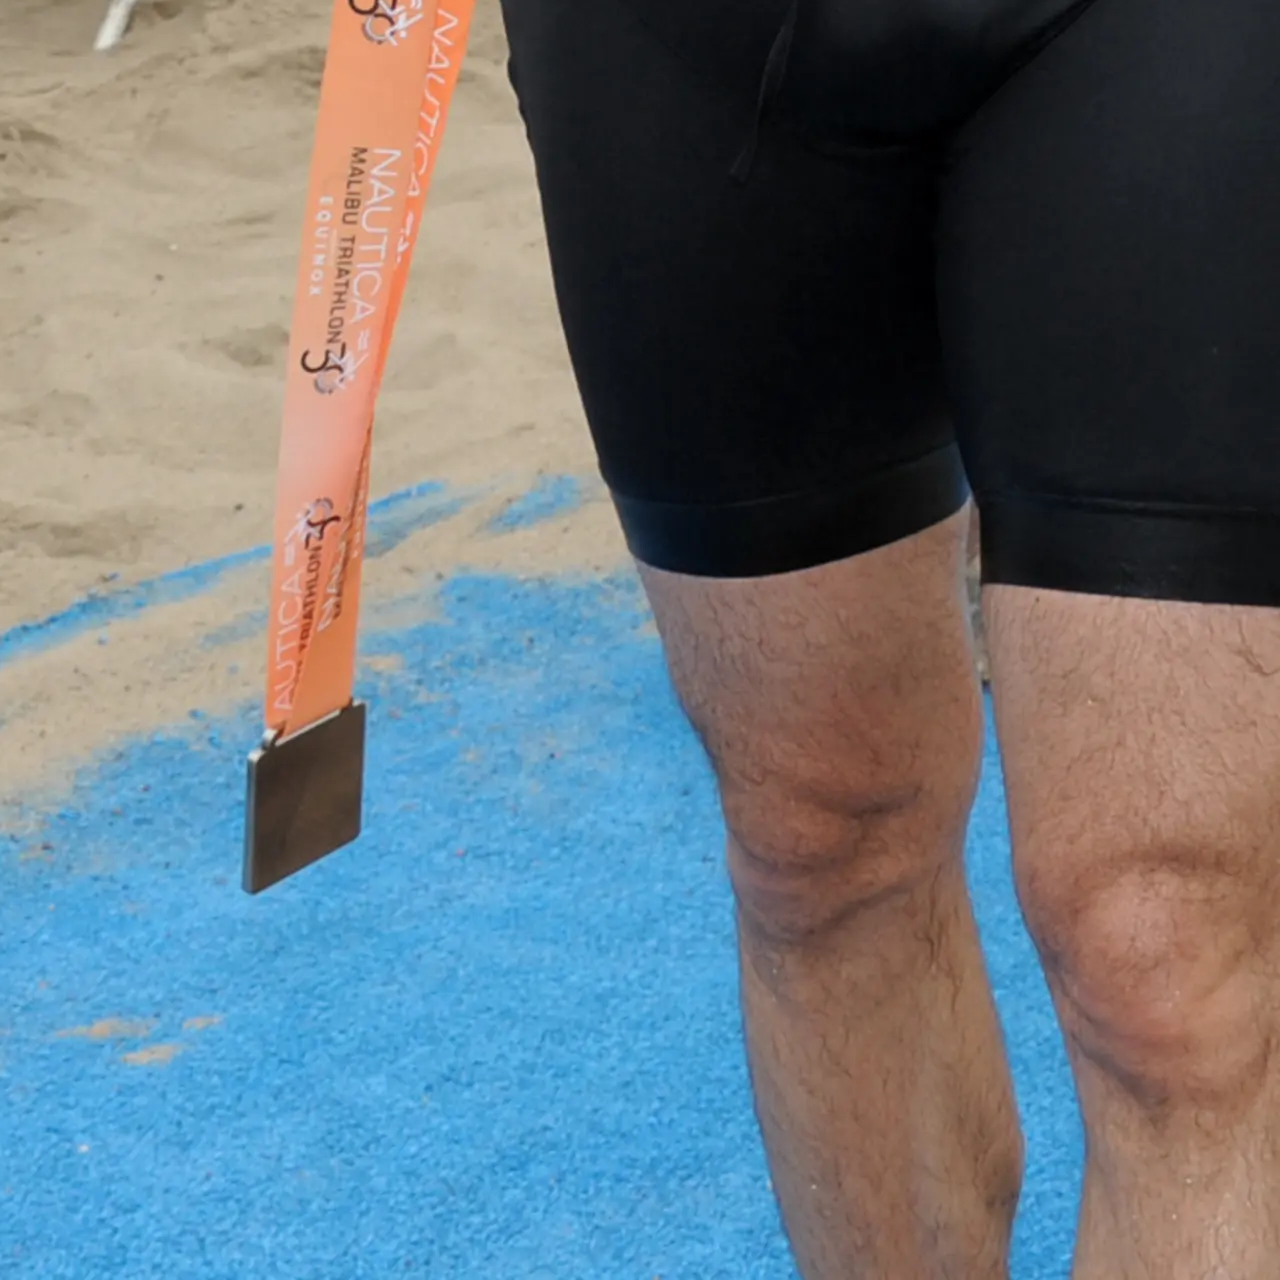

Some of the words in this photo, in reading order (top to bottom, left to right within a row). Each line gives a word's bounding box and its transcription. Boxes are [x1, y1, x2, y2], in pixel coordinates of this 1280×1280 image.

[341, 146, 369, 227] MALIBU
[348, 147, 402, 325] NAUTICA
[309, 194, 334, 297] EQUINOX
[325, 234, 357, 346] TRIATHLON
